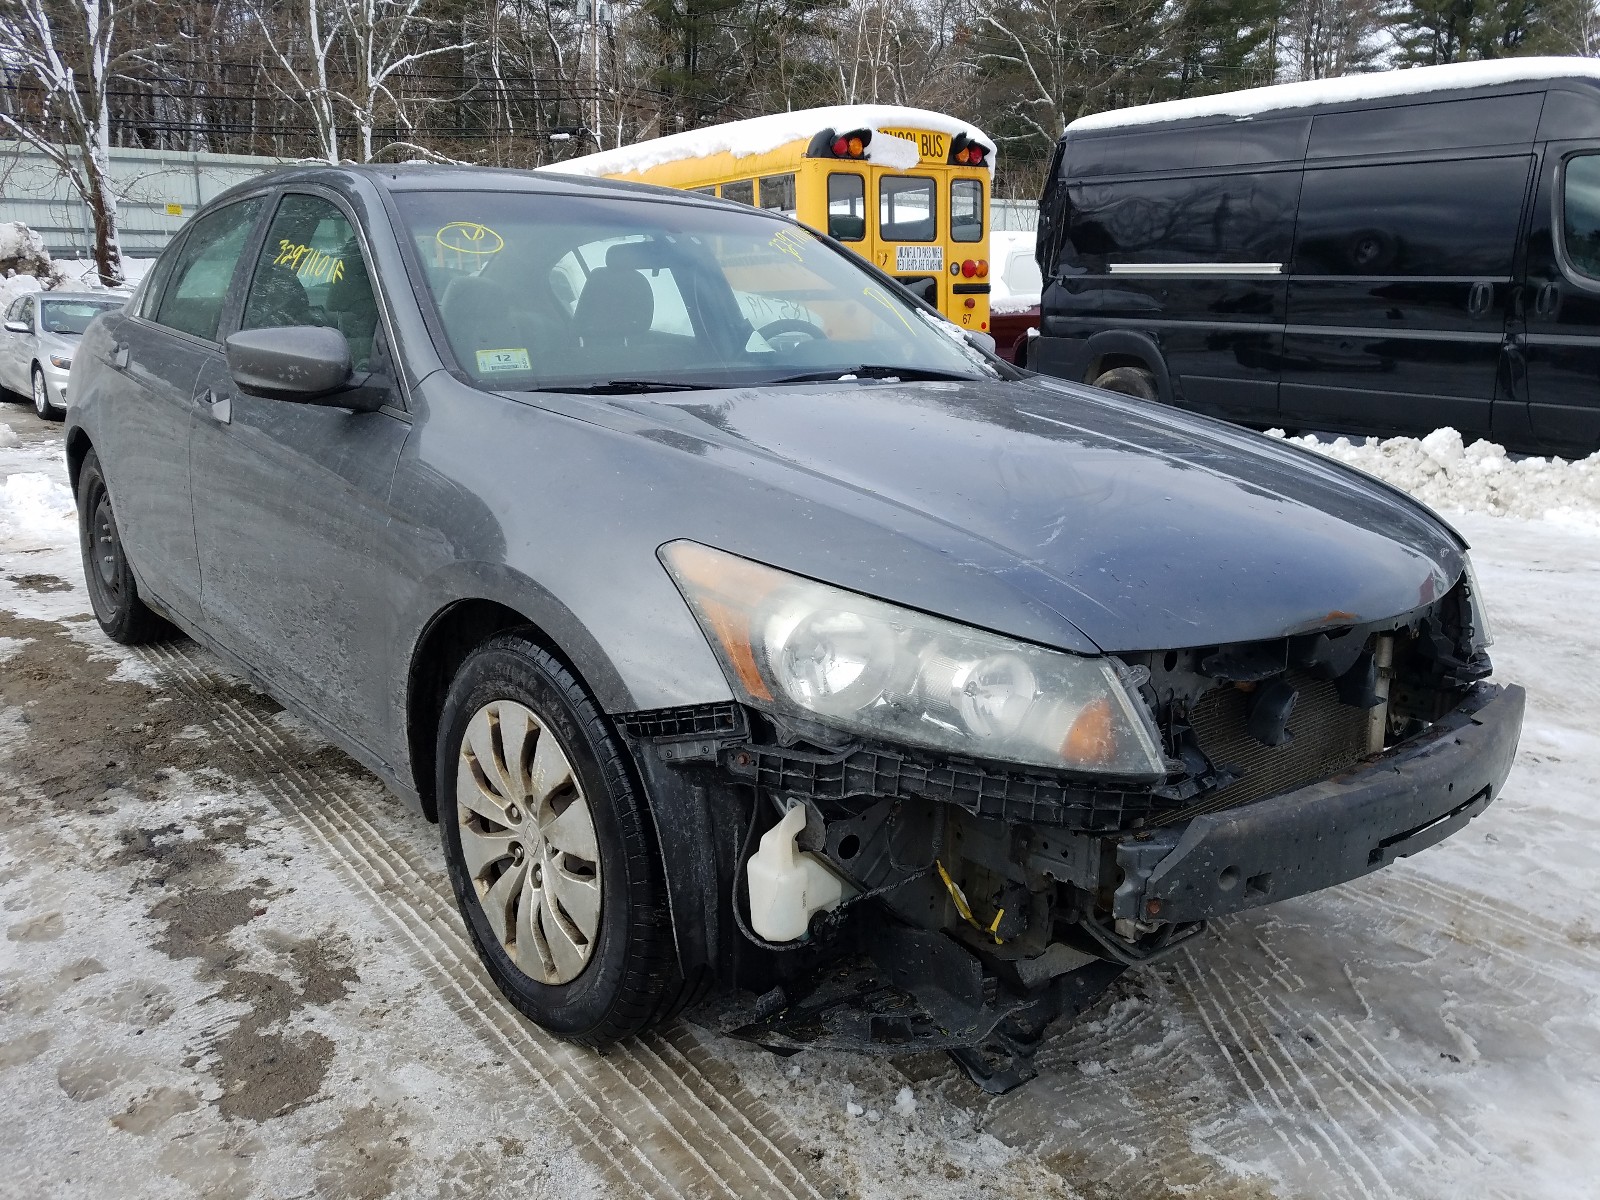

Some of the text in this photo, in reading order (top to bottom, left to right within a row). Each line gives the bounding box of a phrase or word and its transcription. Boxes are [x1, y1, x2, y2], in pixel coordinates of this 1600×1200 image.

[921, 133, 943, 157] BUS
[962, 313, 972, 325] 67
[494, 354, 512, 362] 12
